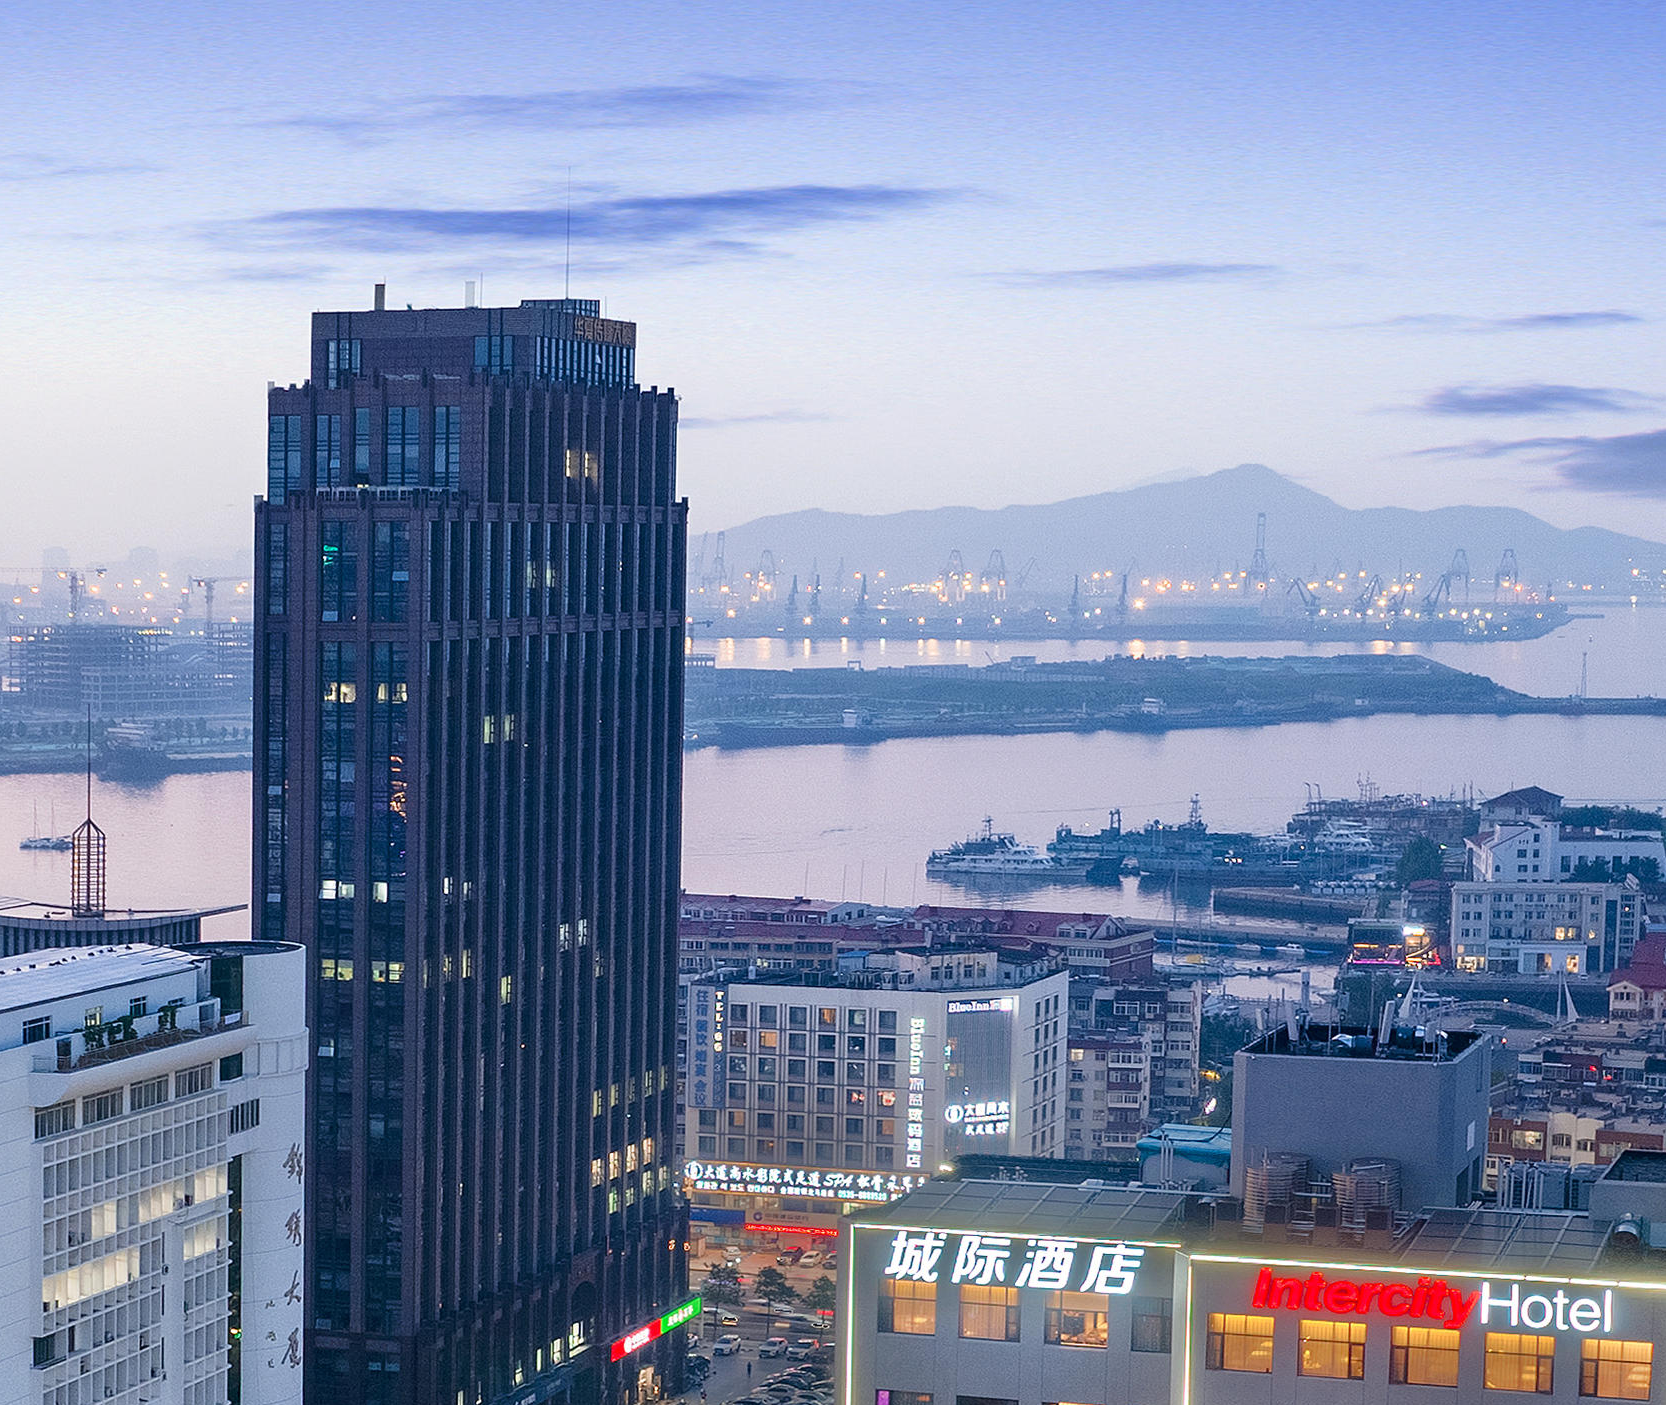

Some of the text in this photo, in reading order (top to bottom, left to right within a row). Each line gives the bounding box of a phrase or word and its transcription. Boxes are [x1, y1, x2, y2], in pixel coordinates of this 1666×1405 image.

[823, 1173, 853, 1188] SPA
[883, 1229, 1146, 1296] 城际酒店
